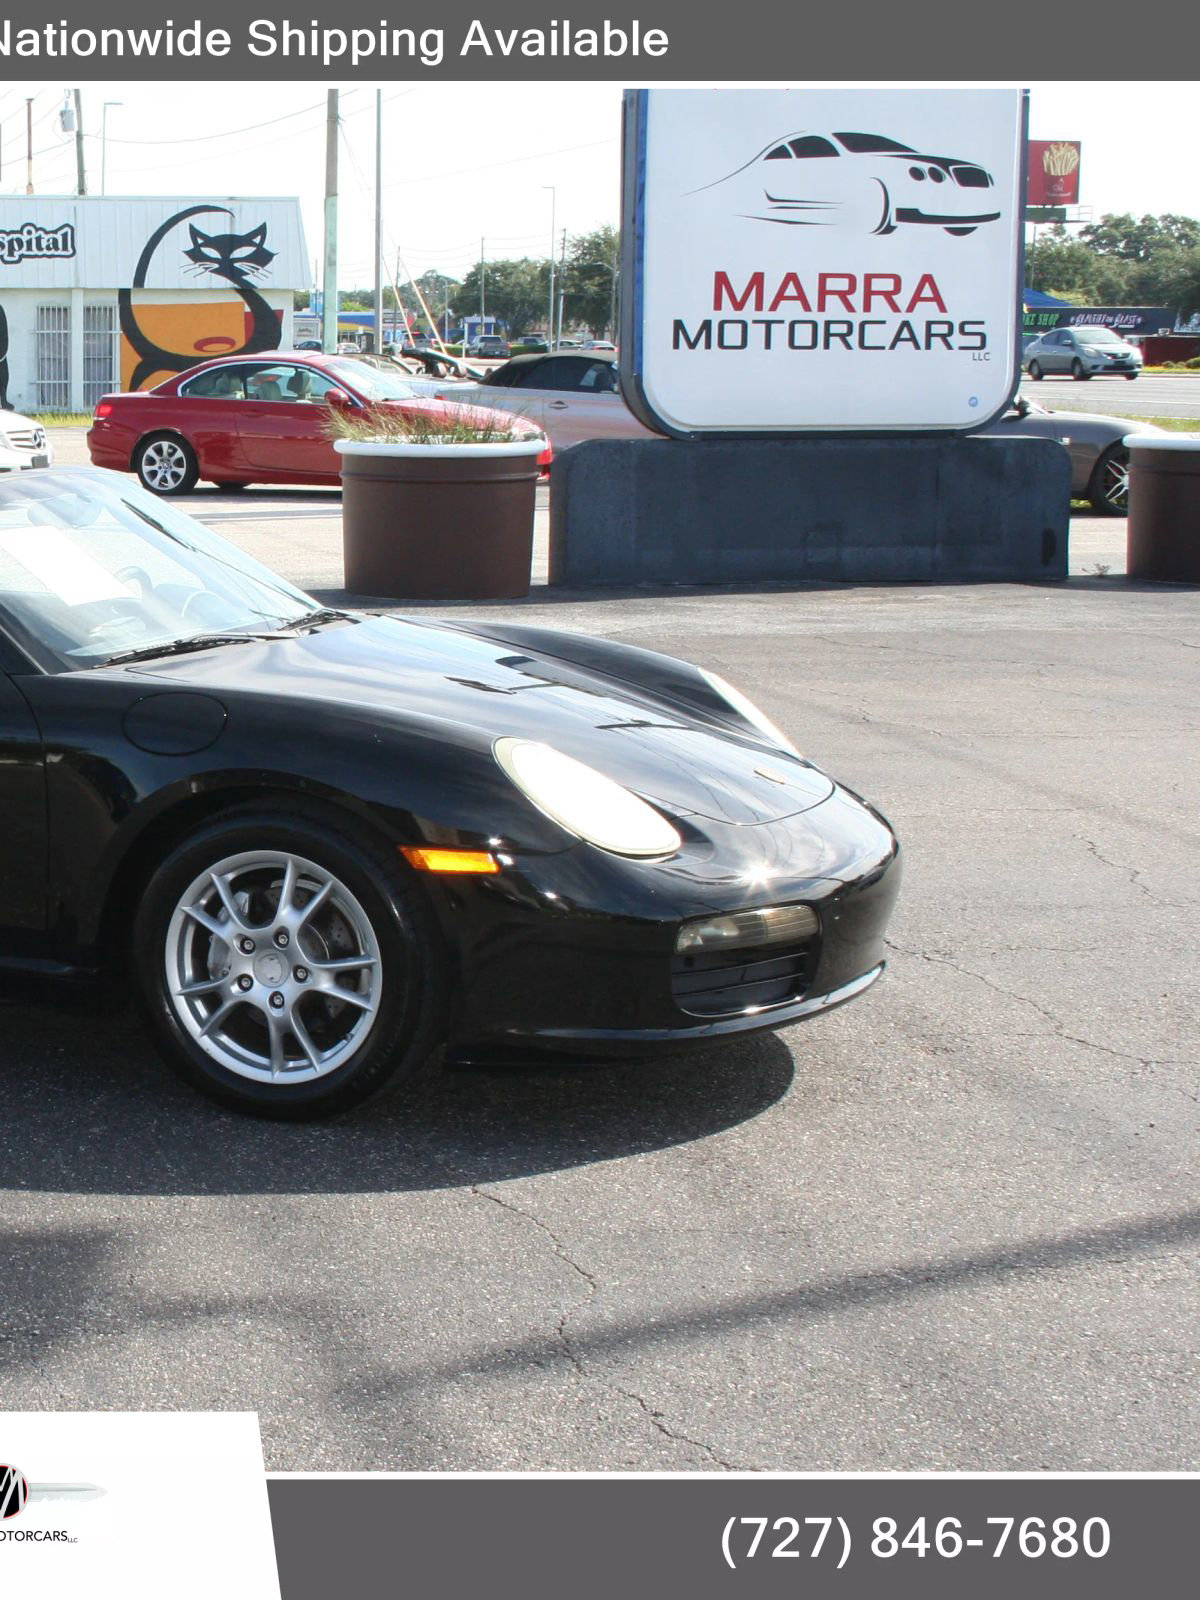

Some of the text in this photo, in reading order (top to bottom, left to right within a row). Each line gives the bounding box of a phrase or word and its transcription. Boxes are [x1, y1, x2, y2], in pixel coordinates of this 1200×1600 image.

[713, 270, 947, 313] MARRA
[1037, 313, 1060, 326] SHOP
[672, 319, 988, 351] MOTORCARS
[972, 352, 991, 361] LLC
